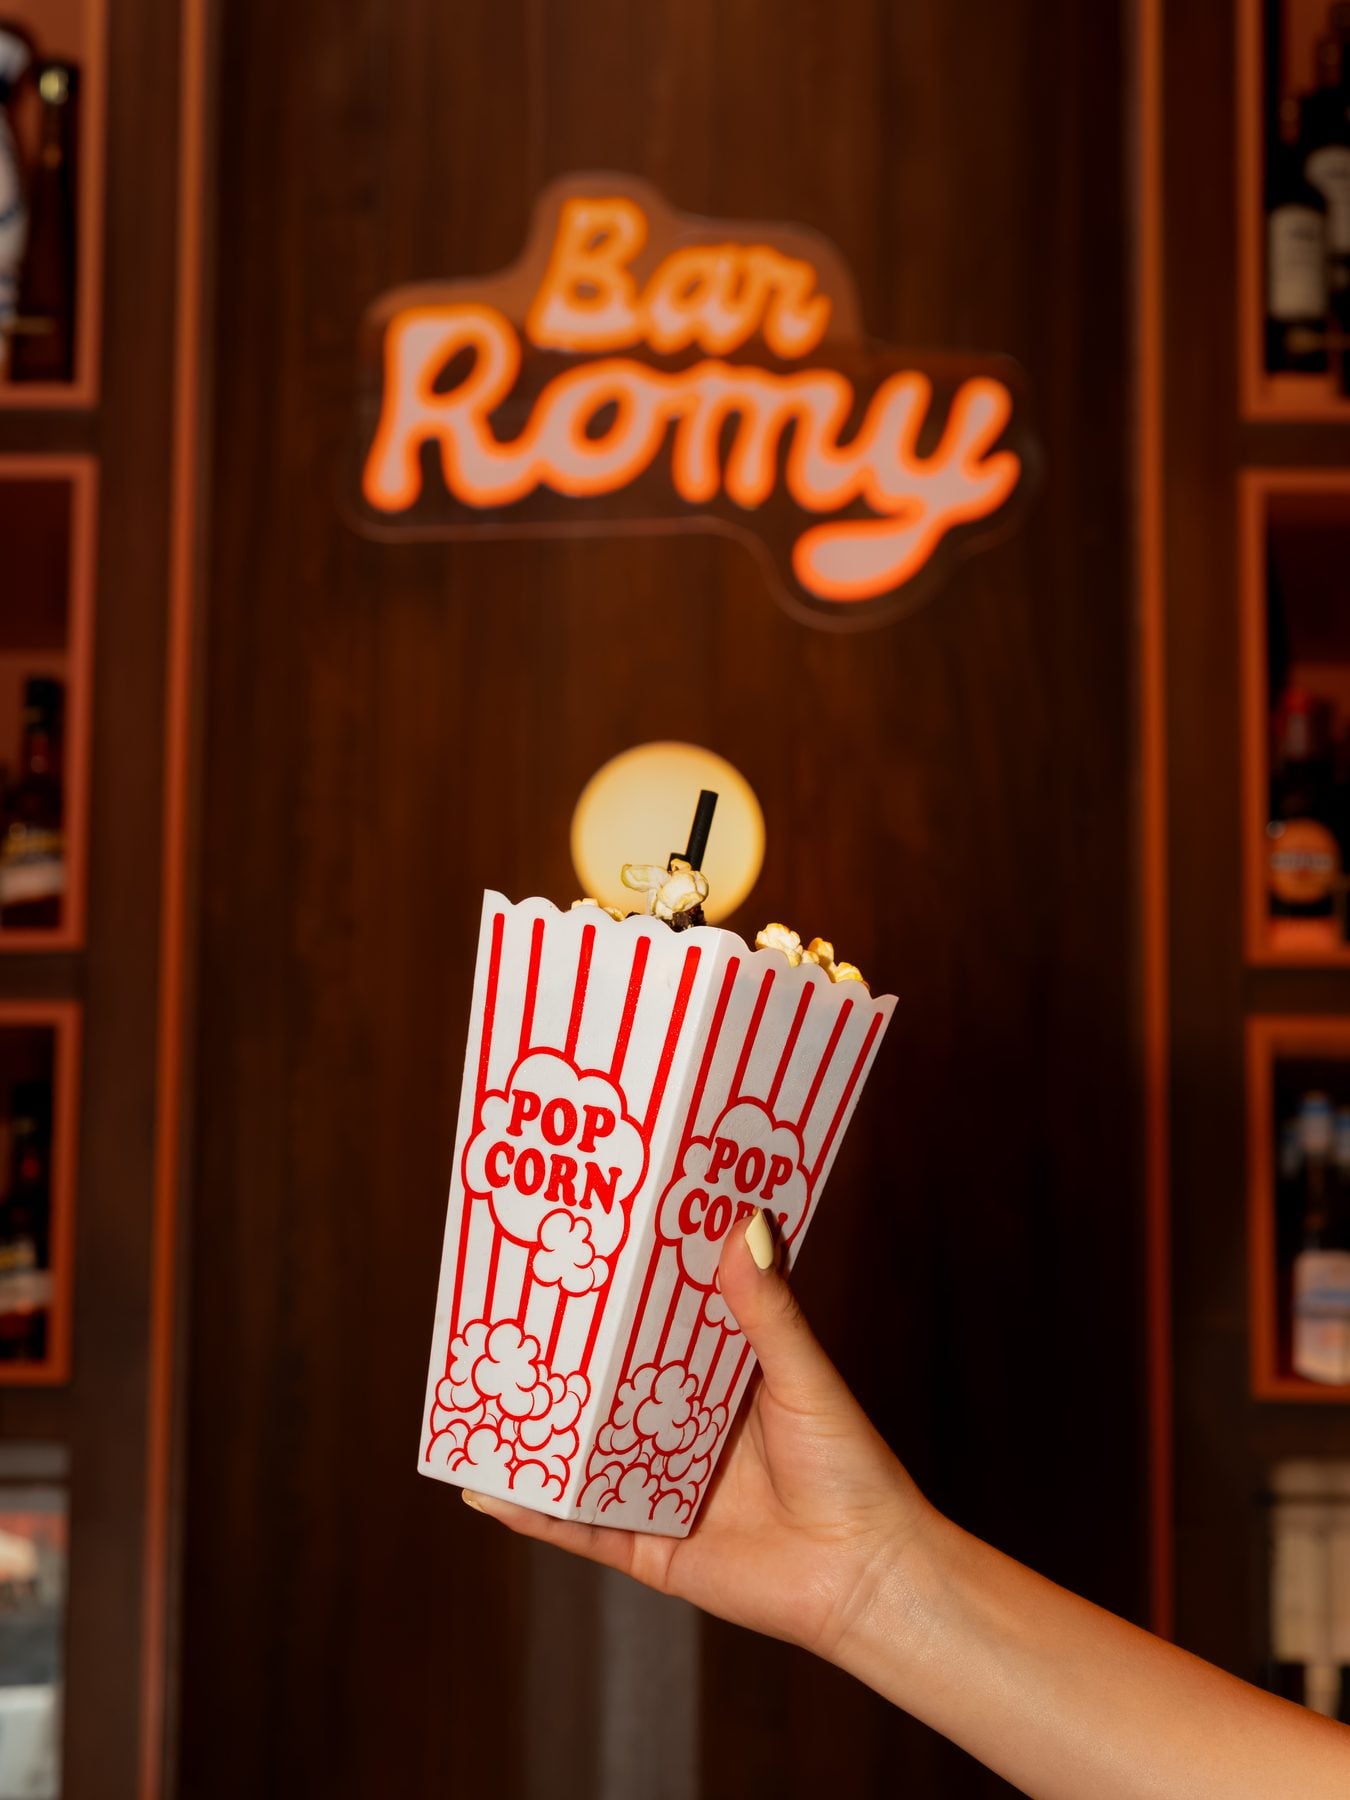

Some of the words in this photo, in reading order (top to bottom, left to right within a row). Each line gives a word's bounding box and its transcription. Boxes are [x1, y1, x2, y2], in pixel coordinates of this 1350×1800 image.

[527, 197, 830, 358] Bar
[363, 303, 1020, 600] Romy
[506, 1089, 616, 1152] POP
[484, 1141, 622, 1214] CORN
[704, 1137, 793, 1200] POP
